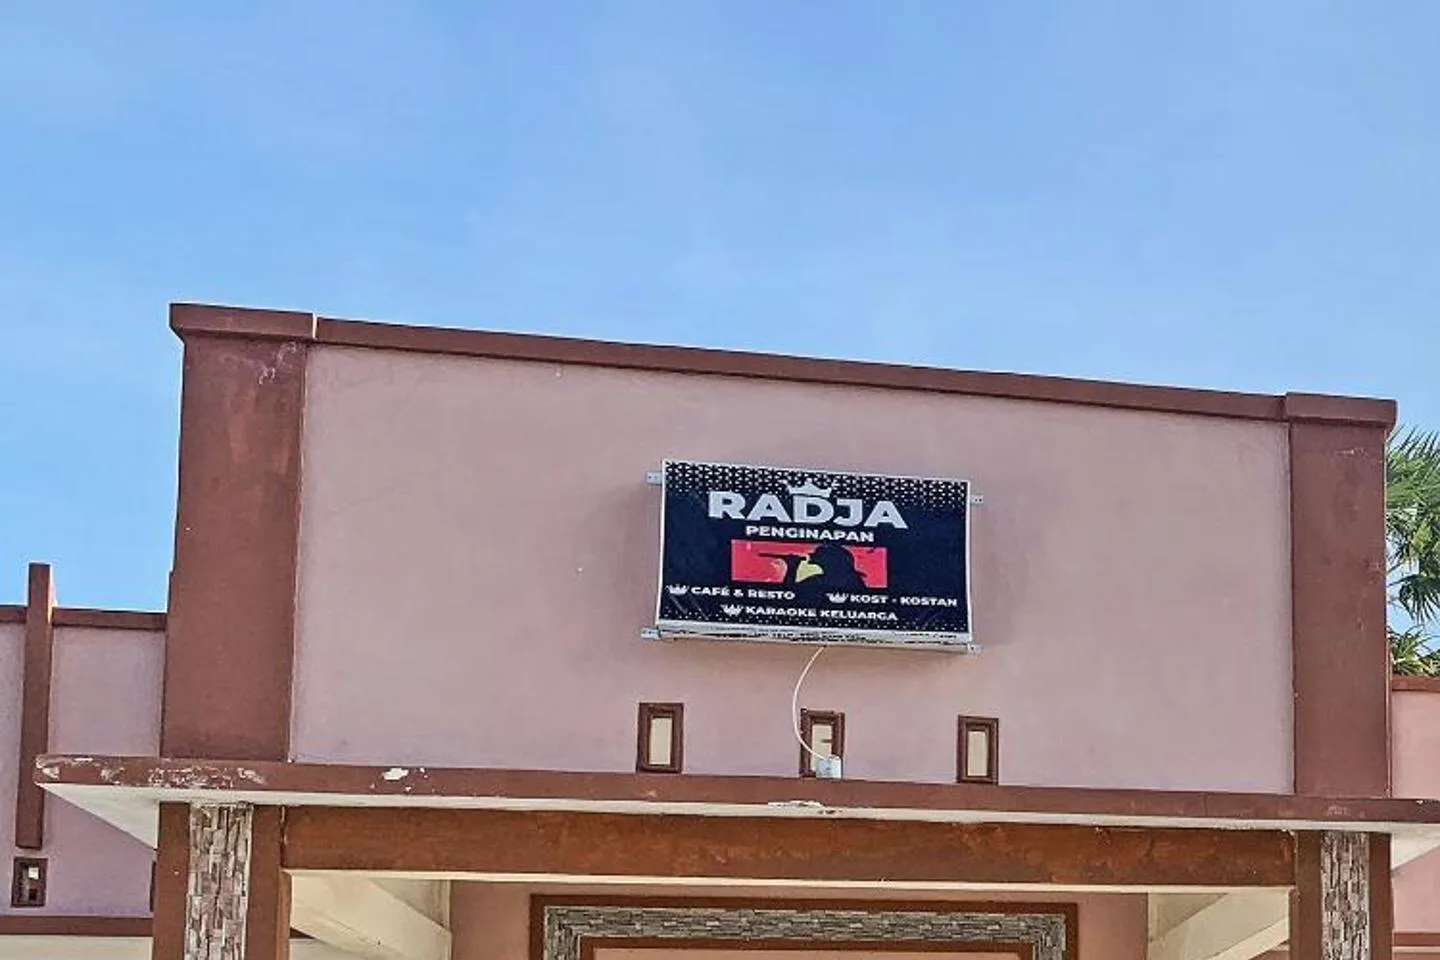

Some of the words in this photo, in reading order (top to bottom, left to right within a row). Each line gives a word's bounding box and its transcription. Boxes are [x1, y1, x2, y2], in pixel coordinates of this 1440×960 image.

[708, 491, 908, 529] RADJA
[690, 585, 730, 596] CAFÉ
[732, 588, 744, 597] &
[747, 588, 796, 600] RESTO
[850, 594, 889, 604] KOST
[900, 596, 958, 607] KOSTAN
[745, 606, 818, 618] KARAOKE
